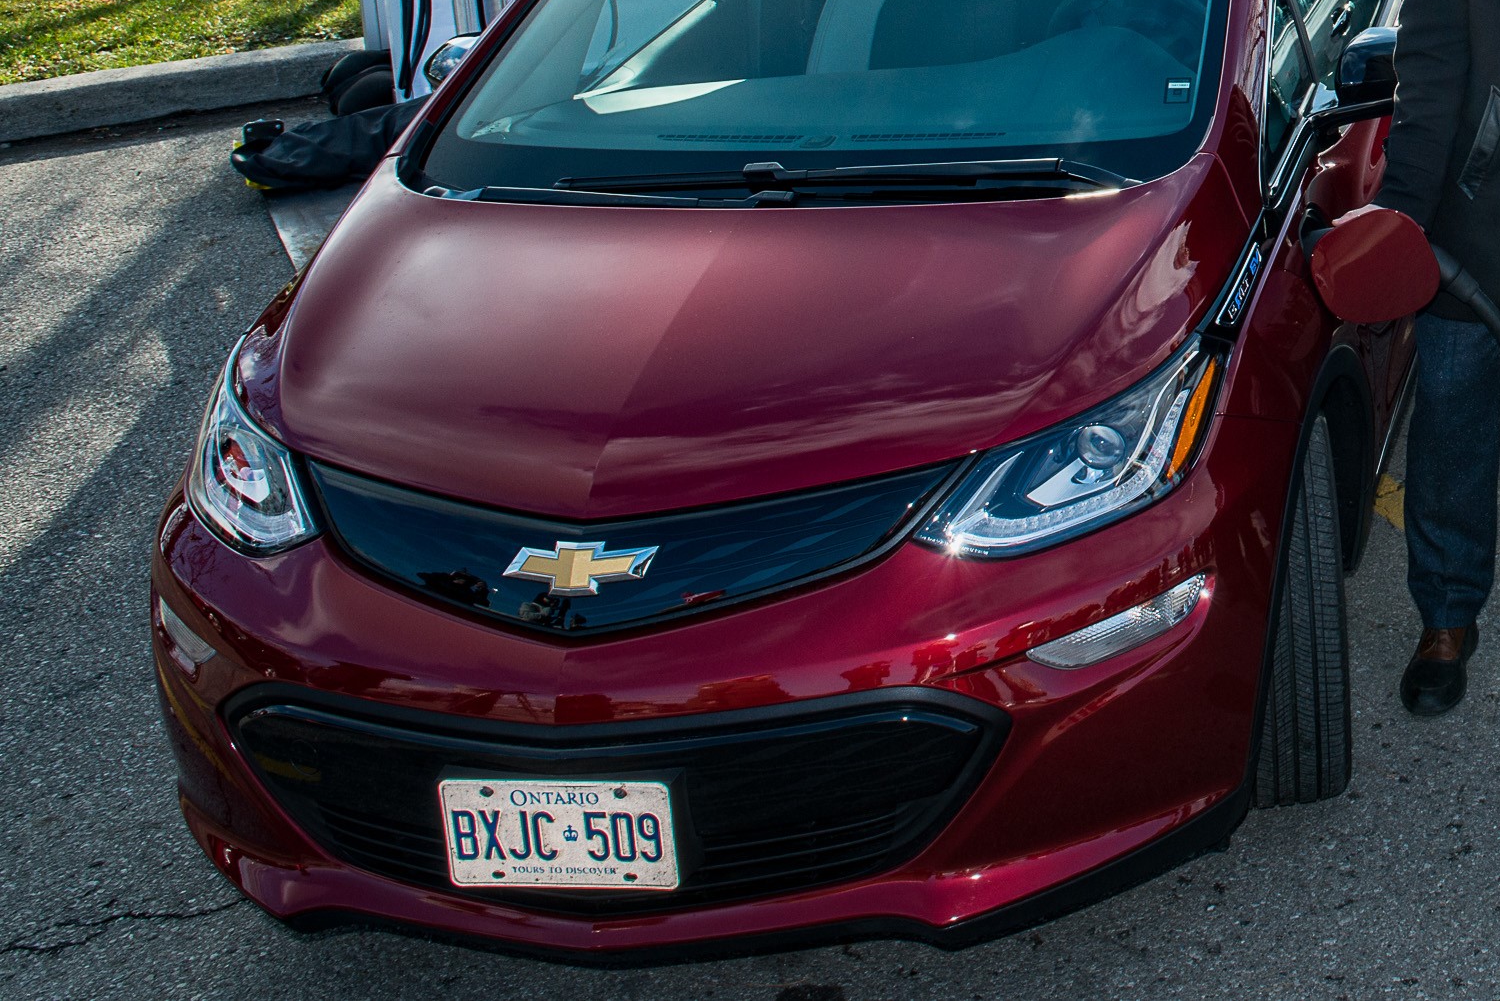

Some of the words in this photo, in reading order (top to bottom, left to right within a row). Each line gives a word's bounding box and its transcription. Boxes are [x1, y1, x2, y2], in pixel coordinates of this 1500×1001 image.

[510, 789, 599, 807] ONTARIO
[451, 810, 559, 861] BXJC
[584, 811, 664, 862] 509
[512, 866, 545, 874] YOURS
[549, 866, 562, 874] TO
[565, 866, 618, 875] DISCOVER
